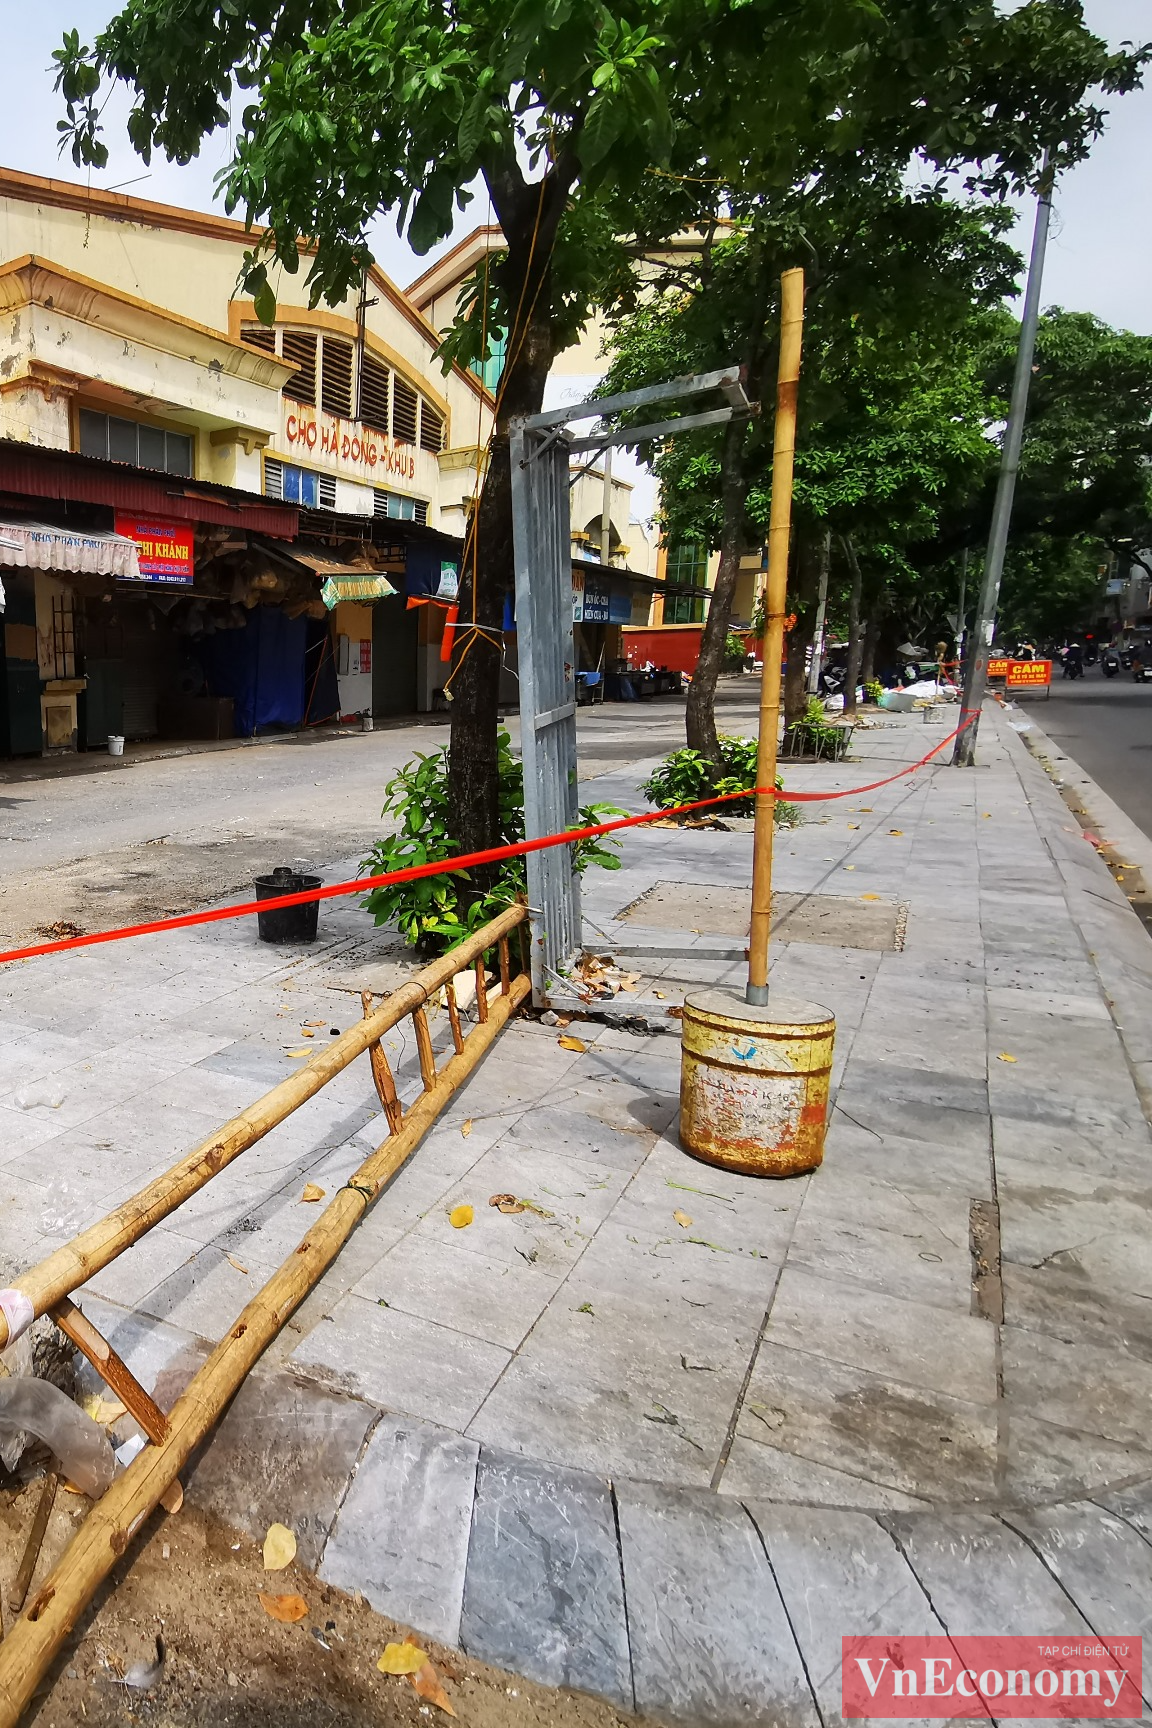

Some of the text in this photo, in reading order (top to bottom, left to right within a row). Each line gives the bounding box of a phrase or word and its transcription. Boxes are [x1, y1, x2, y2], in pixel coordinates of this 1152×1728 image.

[286, 415, 317, 451] CHỢ
[321, 422, 339, 456] HÀ
[341, 433, 377, 467] ĐÔNG
[386, 449, 407, 477] KHU
[408, 455, 415, 480] B
[155, 540, 189, 560] KHÁNH
[1012, 662, 1045, 674] CẤM
